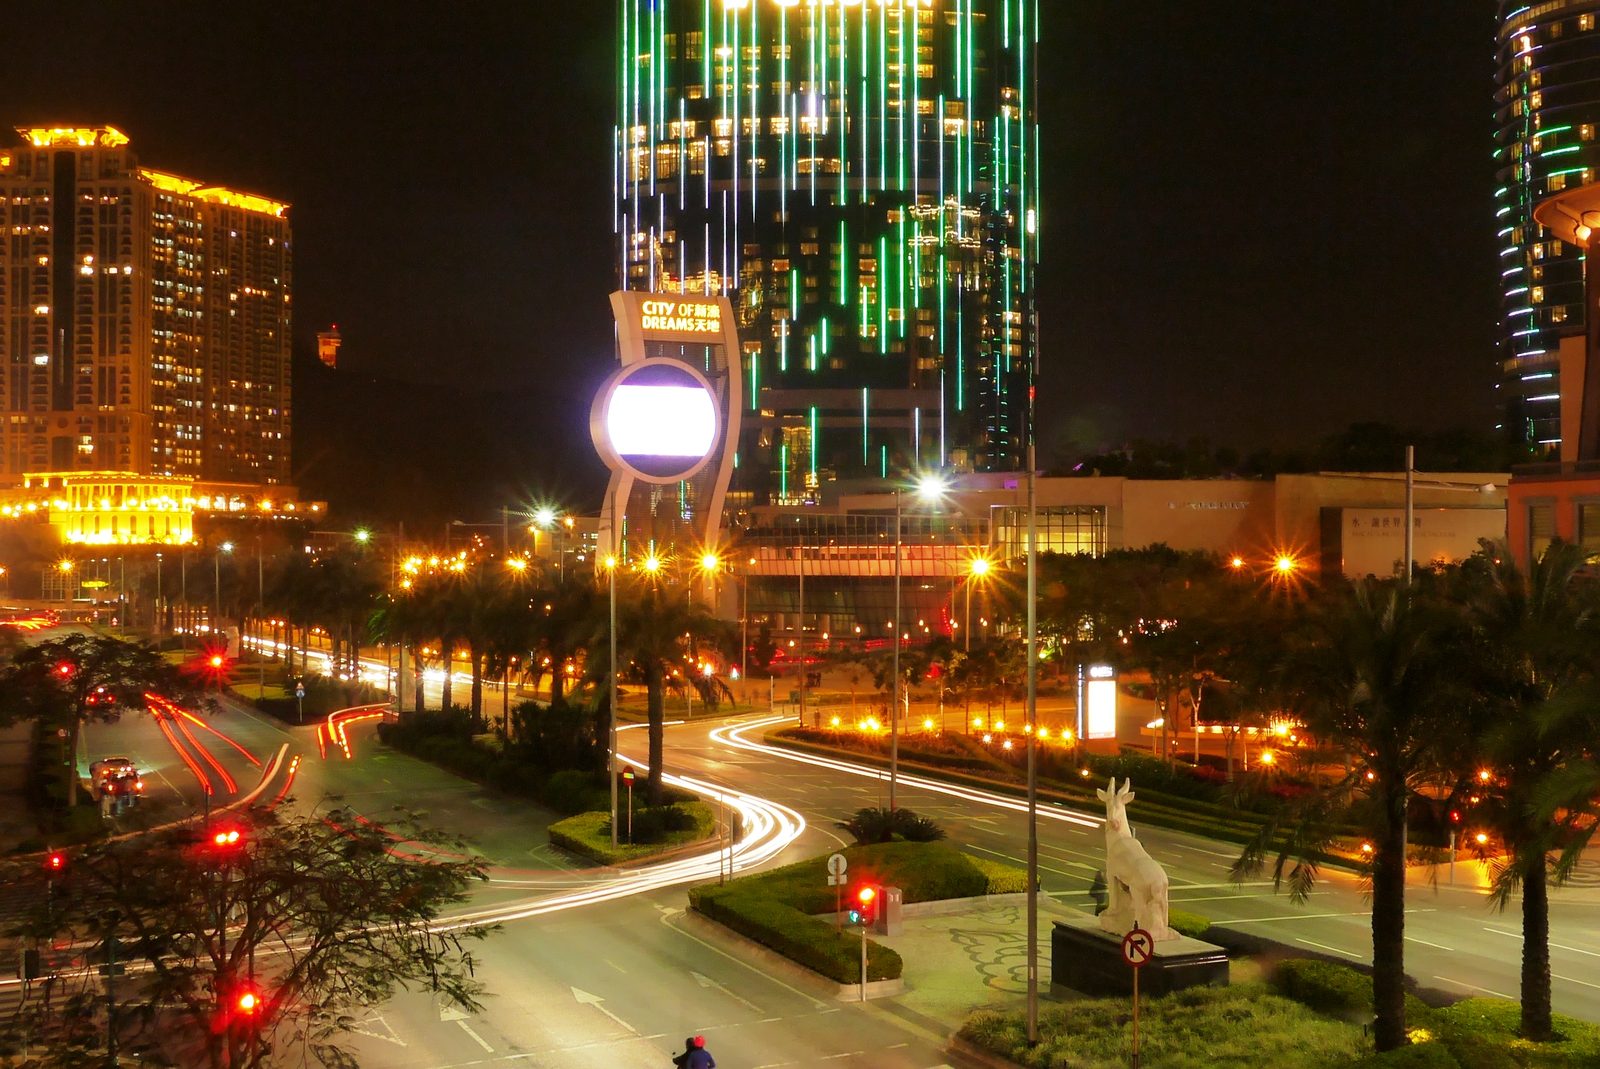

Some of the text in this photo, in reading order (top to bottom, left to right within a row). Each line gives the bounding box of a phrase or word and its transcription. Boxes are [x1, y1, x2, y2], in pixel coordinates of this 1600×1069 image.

[642, 301, 694, 317] CITY OF
[642, 315, 694, 332] DREAMS
[694, 318, 720, 333] 天地
